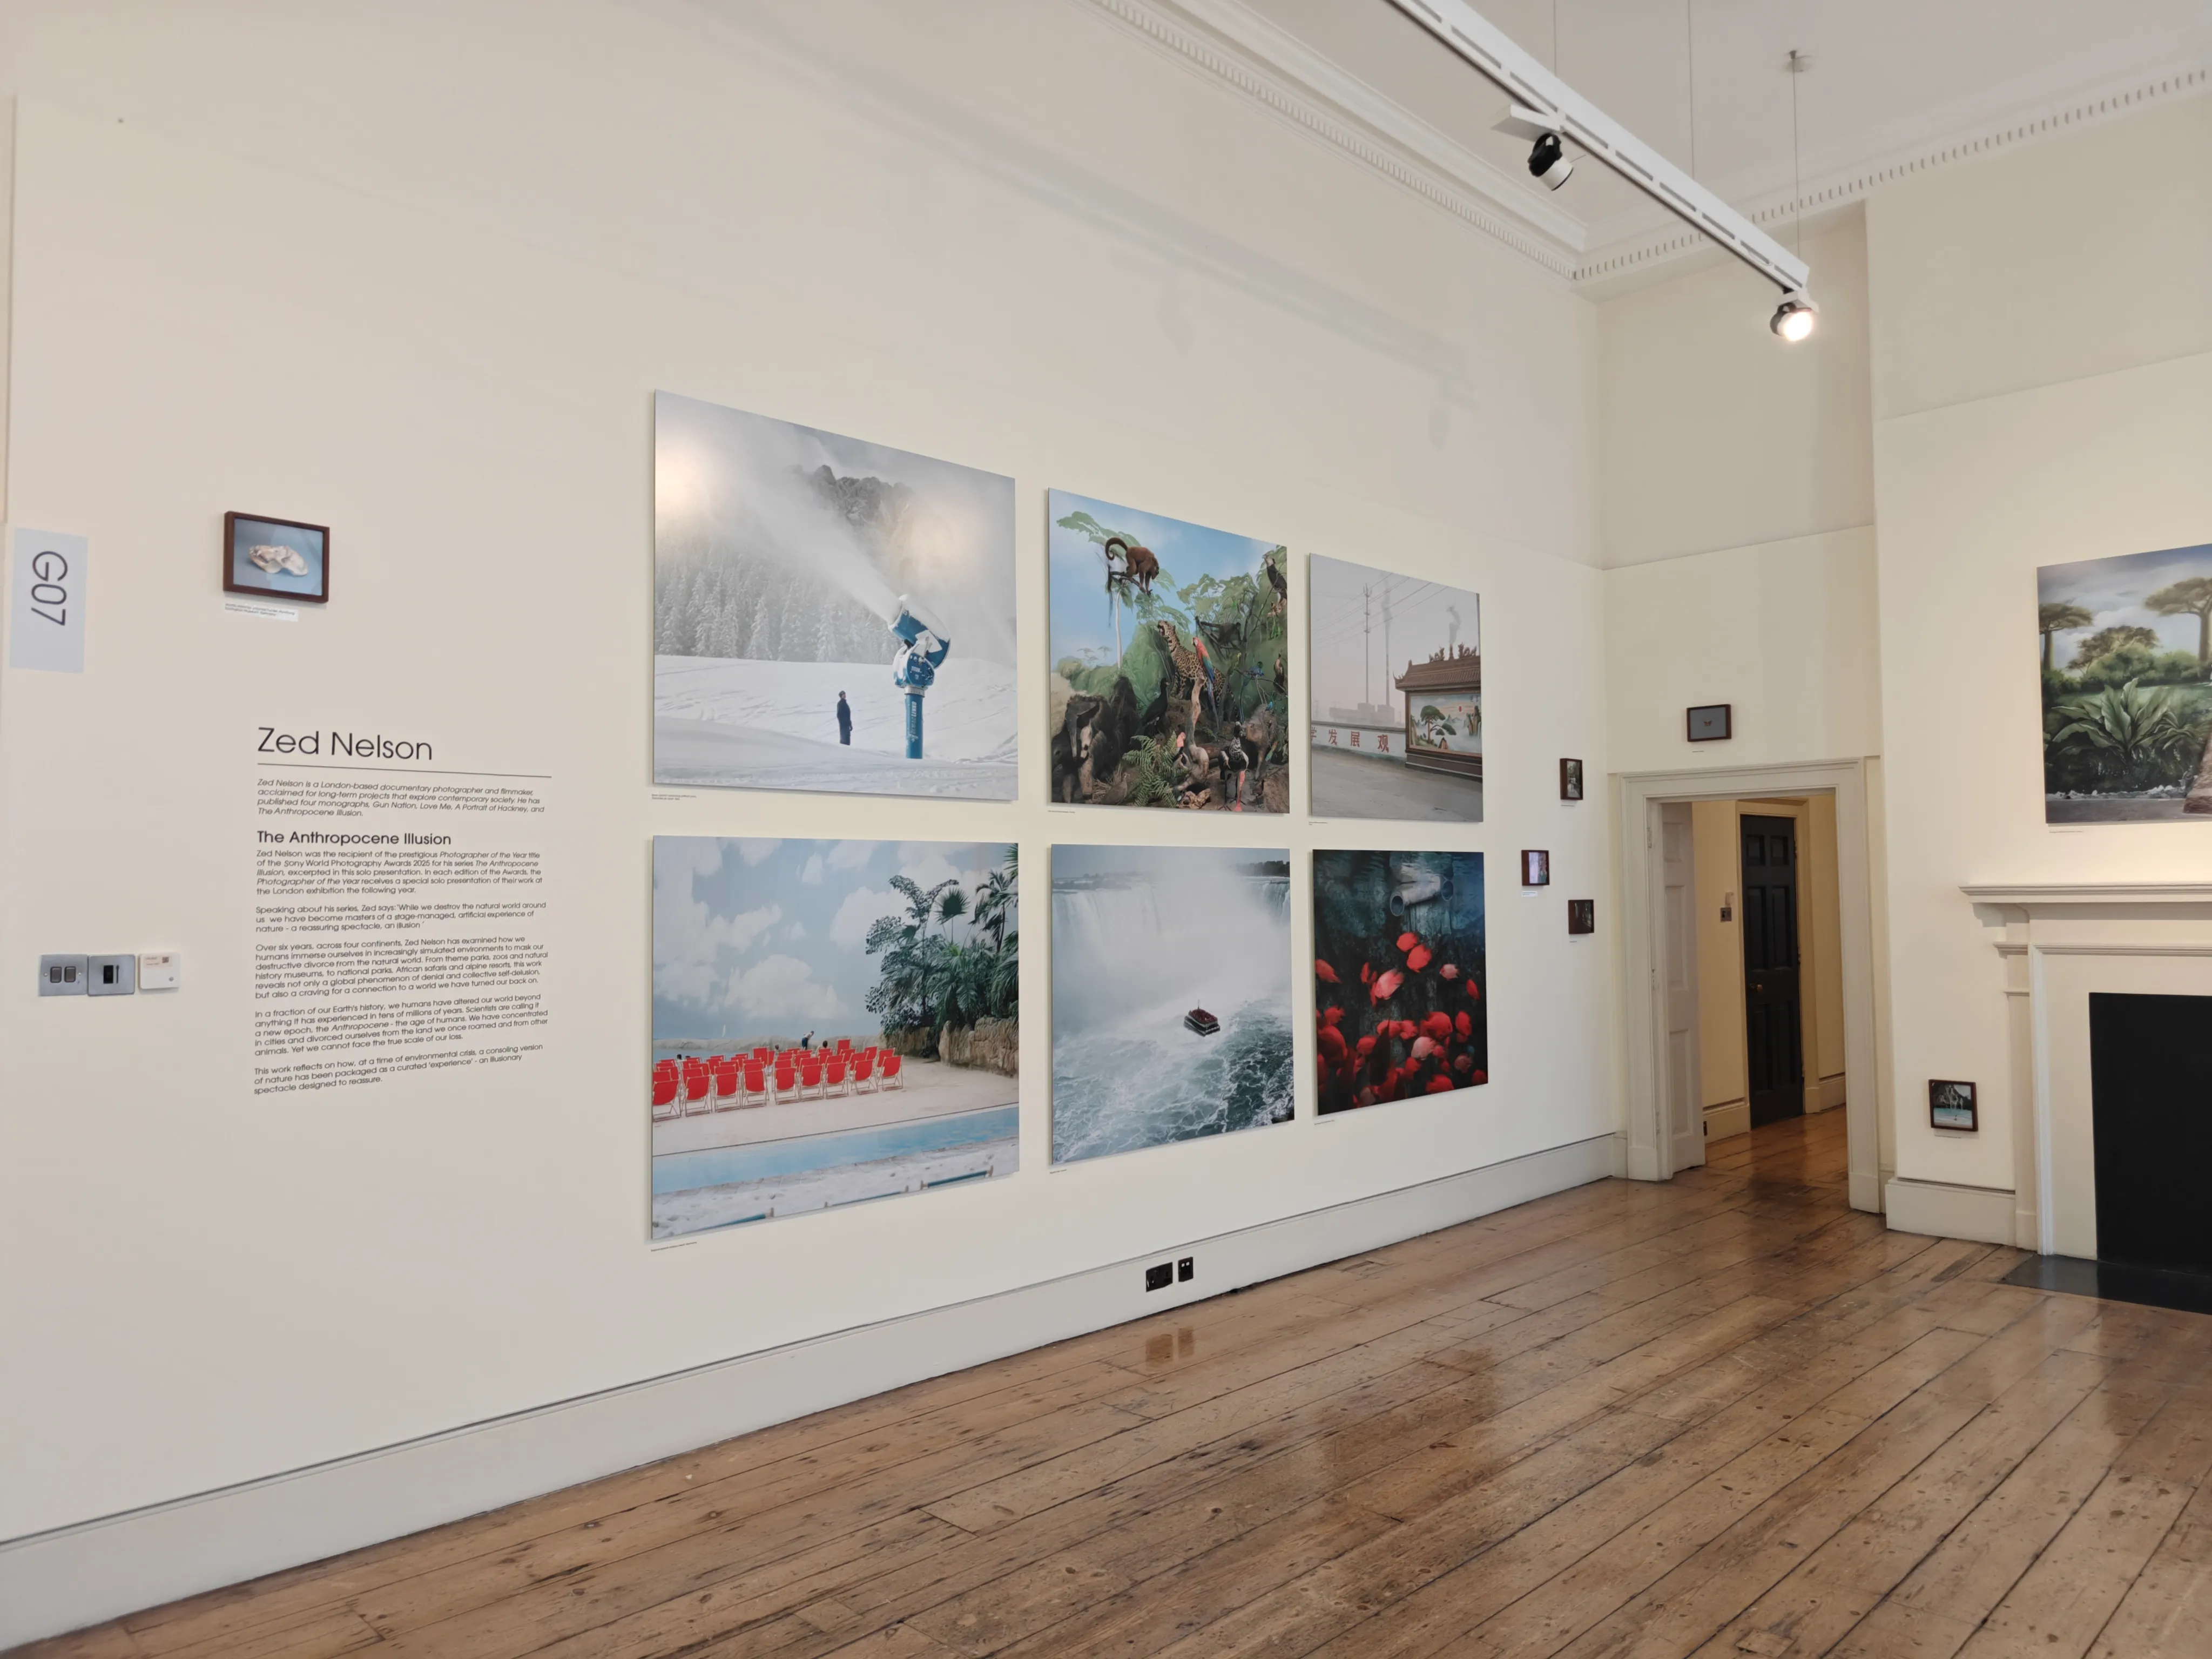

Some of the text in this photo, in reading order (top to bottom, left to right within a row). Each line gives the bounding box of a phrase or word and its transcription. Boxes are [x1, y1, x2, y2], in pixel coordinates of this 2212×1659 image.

[31, 551, 68, 626] G07
[258, 727, 432, 760] Zed Nelson
[321, 781, 379, 790] London-based
[380, 784, 431, 793] documentary
[433, 786, 483, 794] photographer
[318, 791, 357, 799] long-term
[438, 795, 489, 804] contemporary
[274, 807, 334, 816] Anthropocene
[257, 831, 451, 846] The Anthropocene Illusion
[331, 860, 382, 868] Photography
[257, 878, 315, 886] Photographer
[362, 886, 396, 894] following
[330, 977, 355, 987] global
[358, 976, 410, 985] phenomenon
[454, 997, 479, 1005] altered
[515, 994, 541, 1002] beyond
[321, 1042, 350, 1050] cannot
[271, 1065, 291, 1074] work
[293, 1063, 322, 1071] reflects
[404, 1051, 457, 1061] environmental
[486, 1046, 518, 1054] consoling
[254, 1084, 296, 1095] spectacle
[299, 1080, 336, 1090] designed
